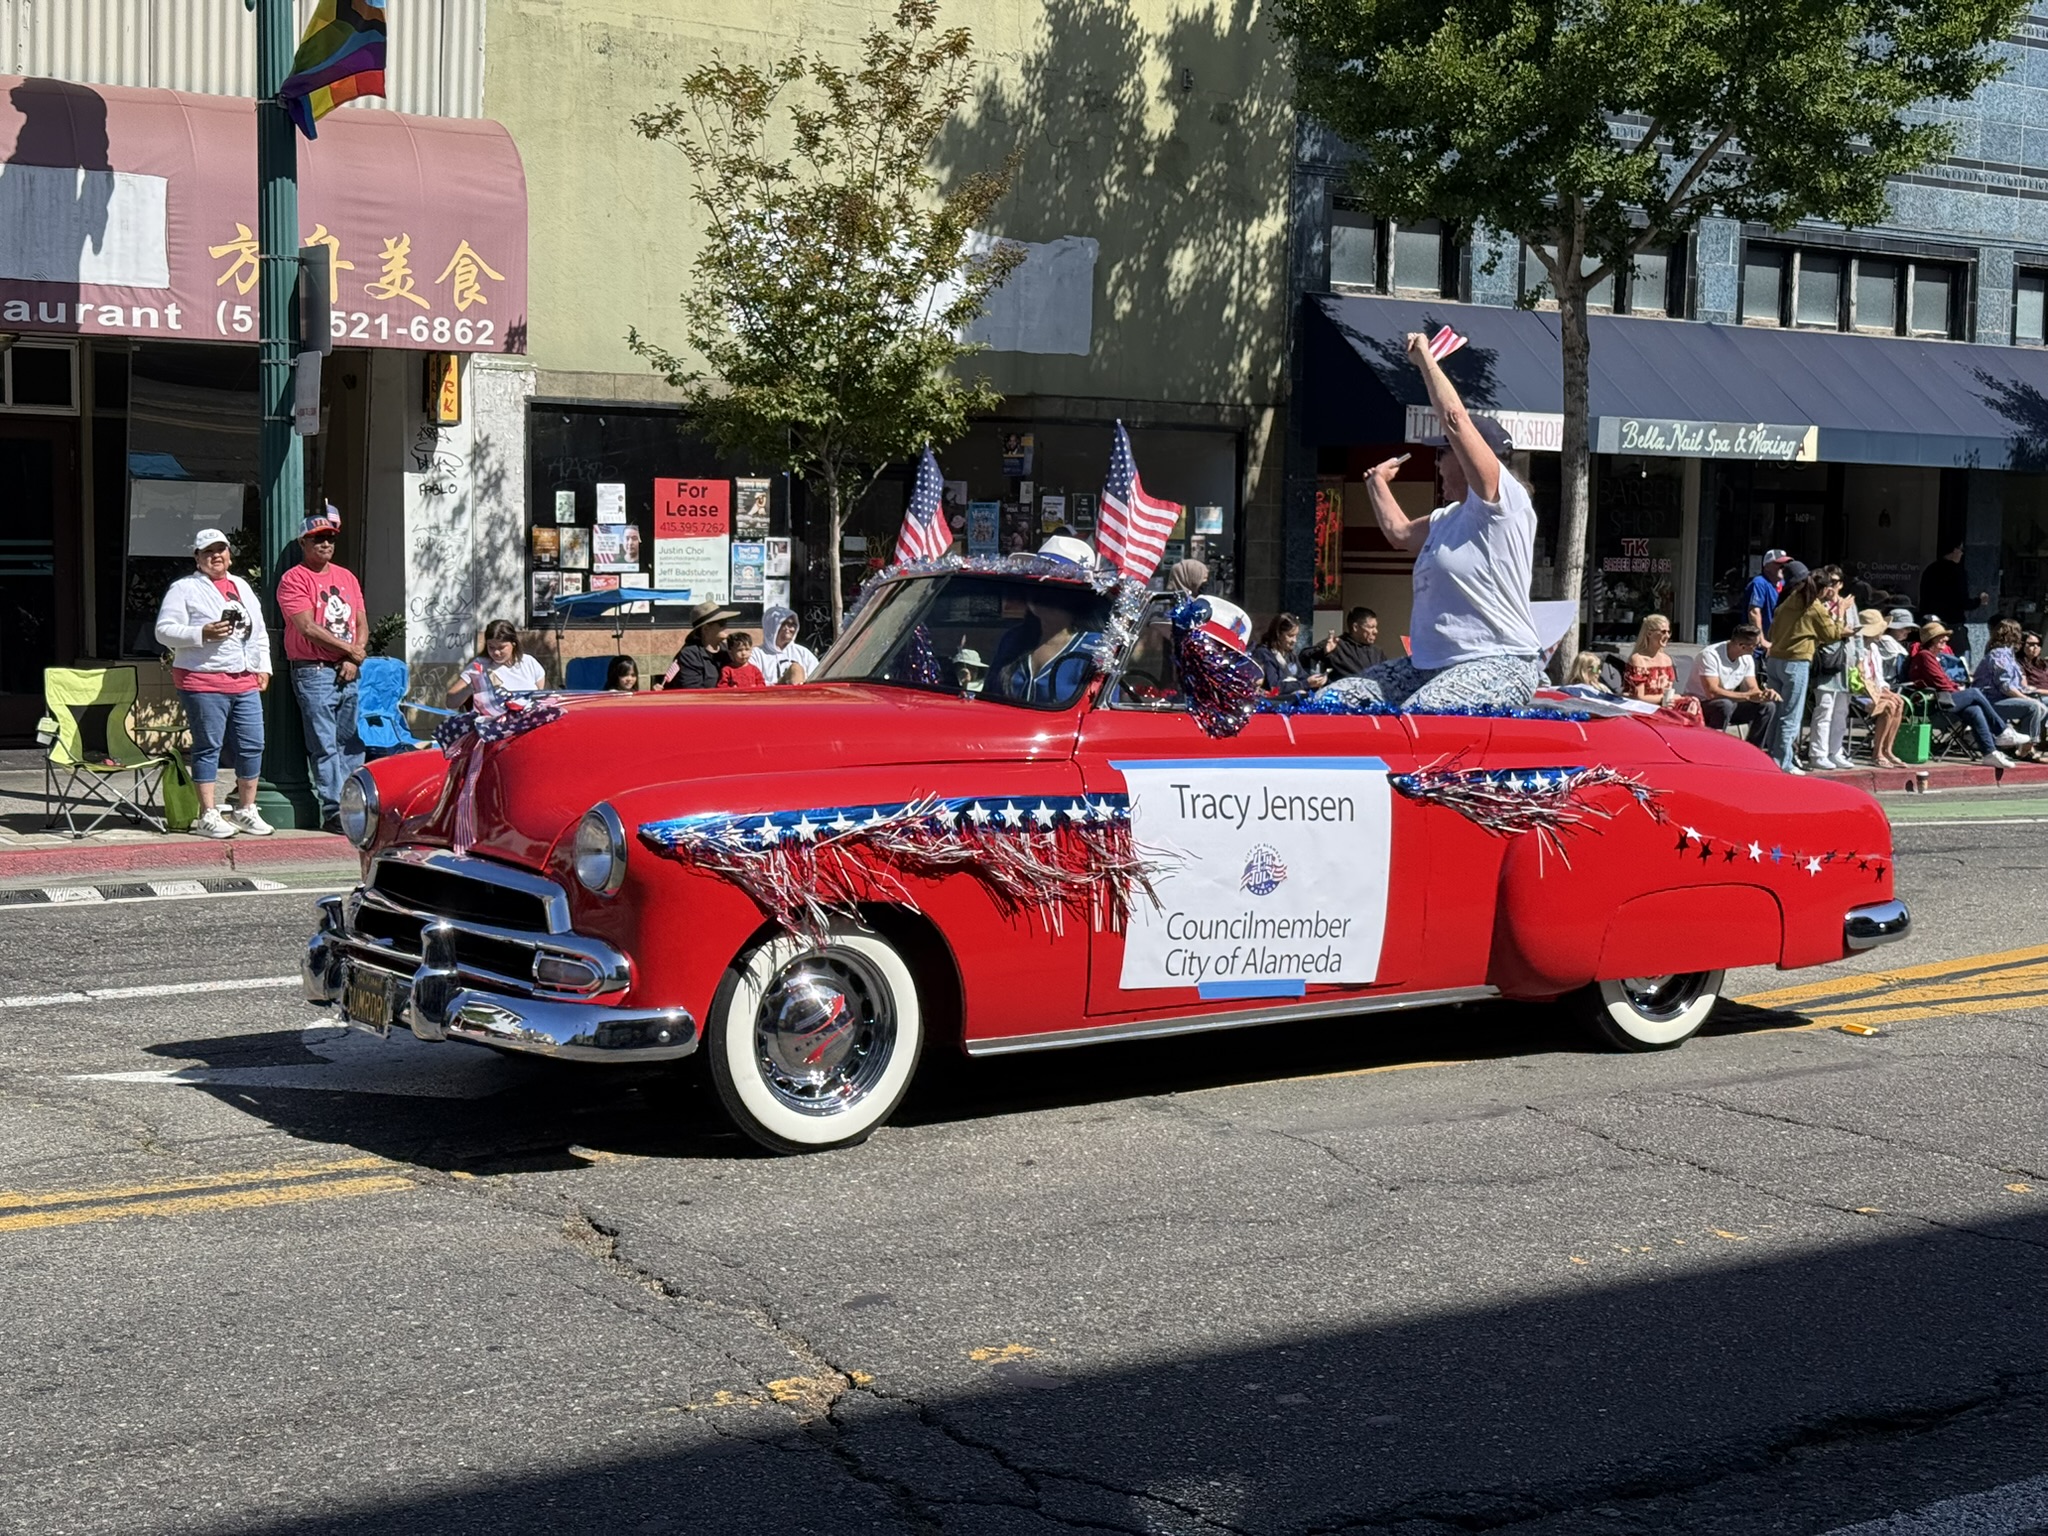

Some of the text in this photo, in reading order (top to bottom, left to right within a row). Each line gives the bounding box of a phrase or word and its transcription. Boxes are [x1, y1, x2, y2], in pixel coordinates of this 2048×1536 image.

[3, 299, 182, 330] aurant
[330, 310, 495, 346] 521-6862
[1622, 421, 1796, 460] Bella Nail Spa & Waxing
[677, 482, 708, 498] For
[666, 501, 718, 517] Lease
[660, 522, 725, 533] 415.395.7262
[658, 546, 704, 555] Justin Choi
[1621, 538, 1649, 556] TK
[658, 568, 673, 576] Jeff
[1170, 784, 1354, 830] Tracy Jensen
[1248, 868, 1274, 886] JULY
[1166, 910, 1351, 940] Councilmember
[1165, 945, 1342, 983] City of Alameda
